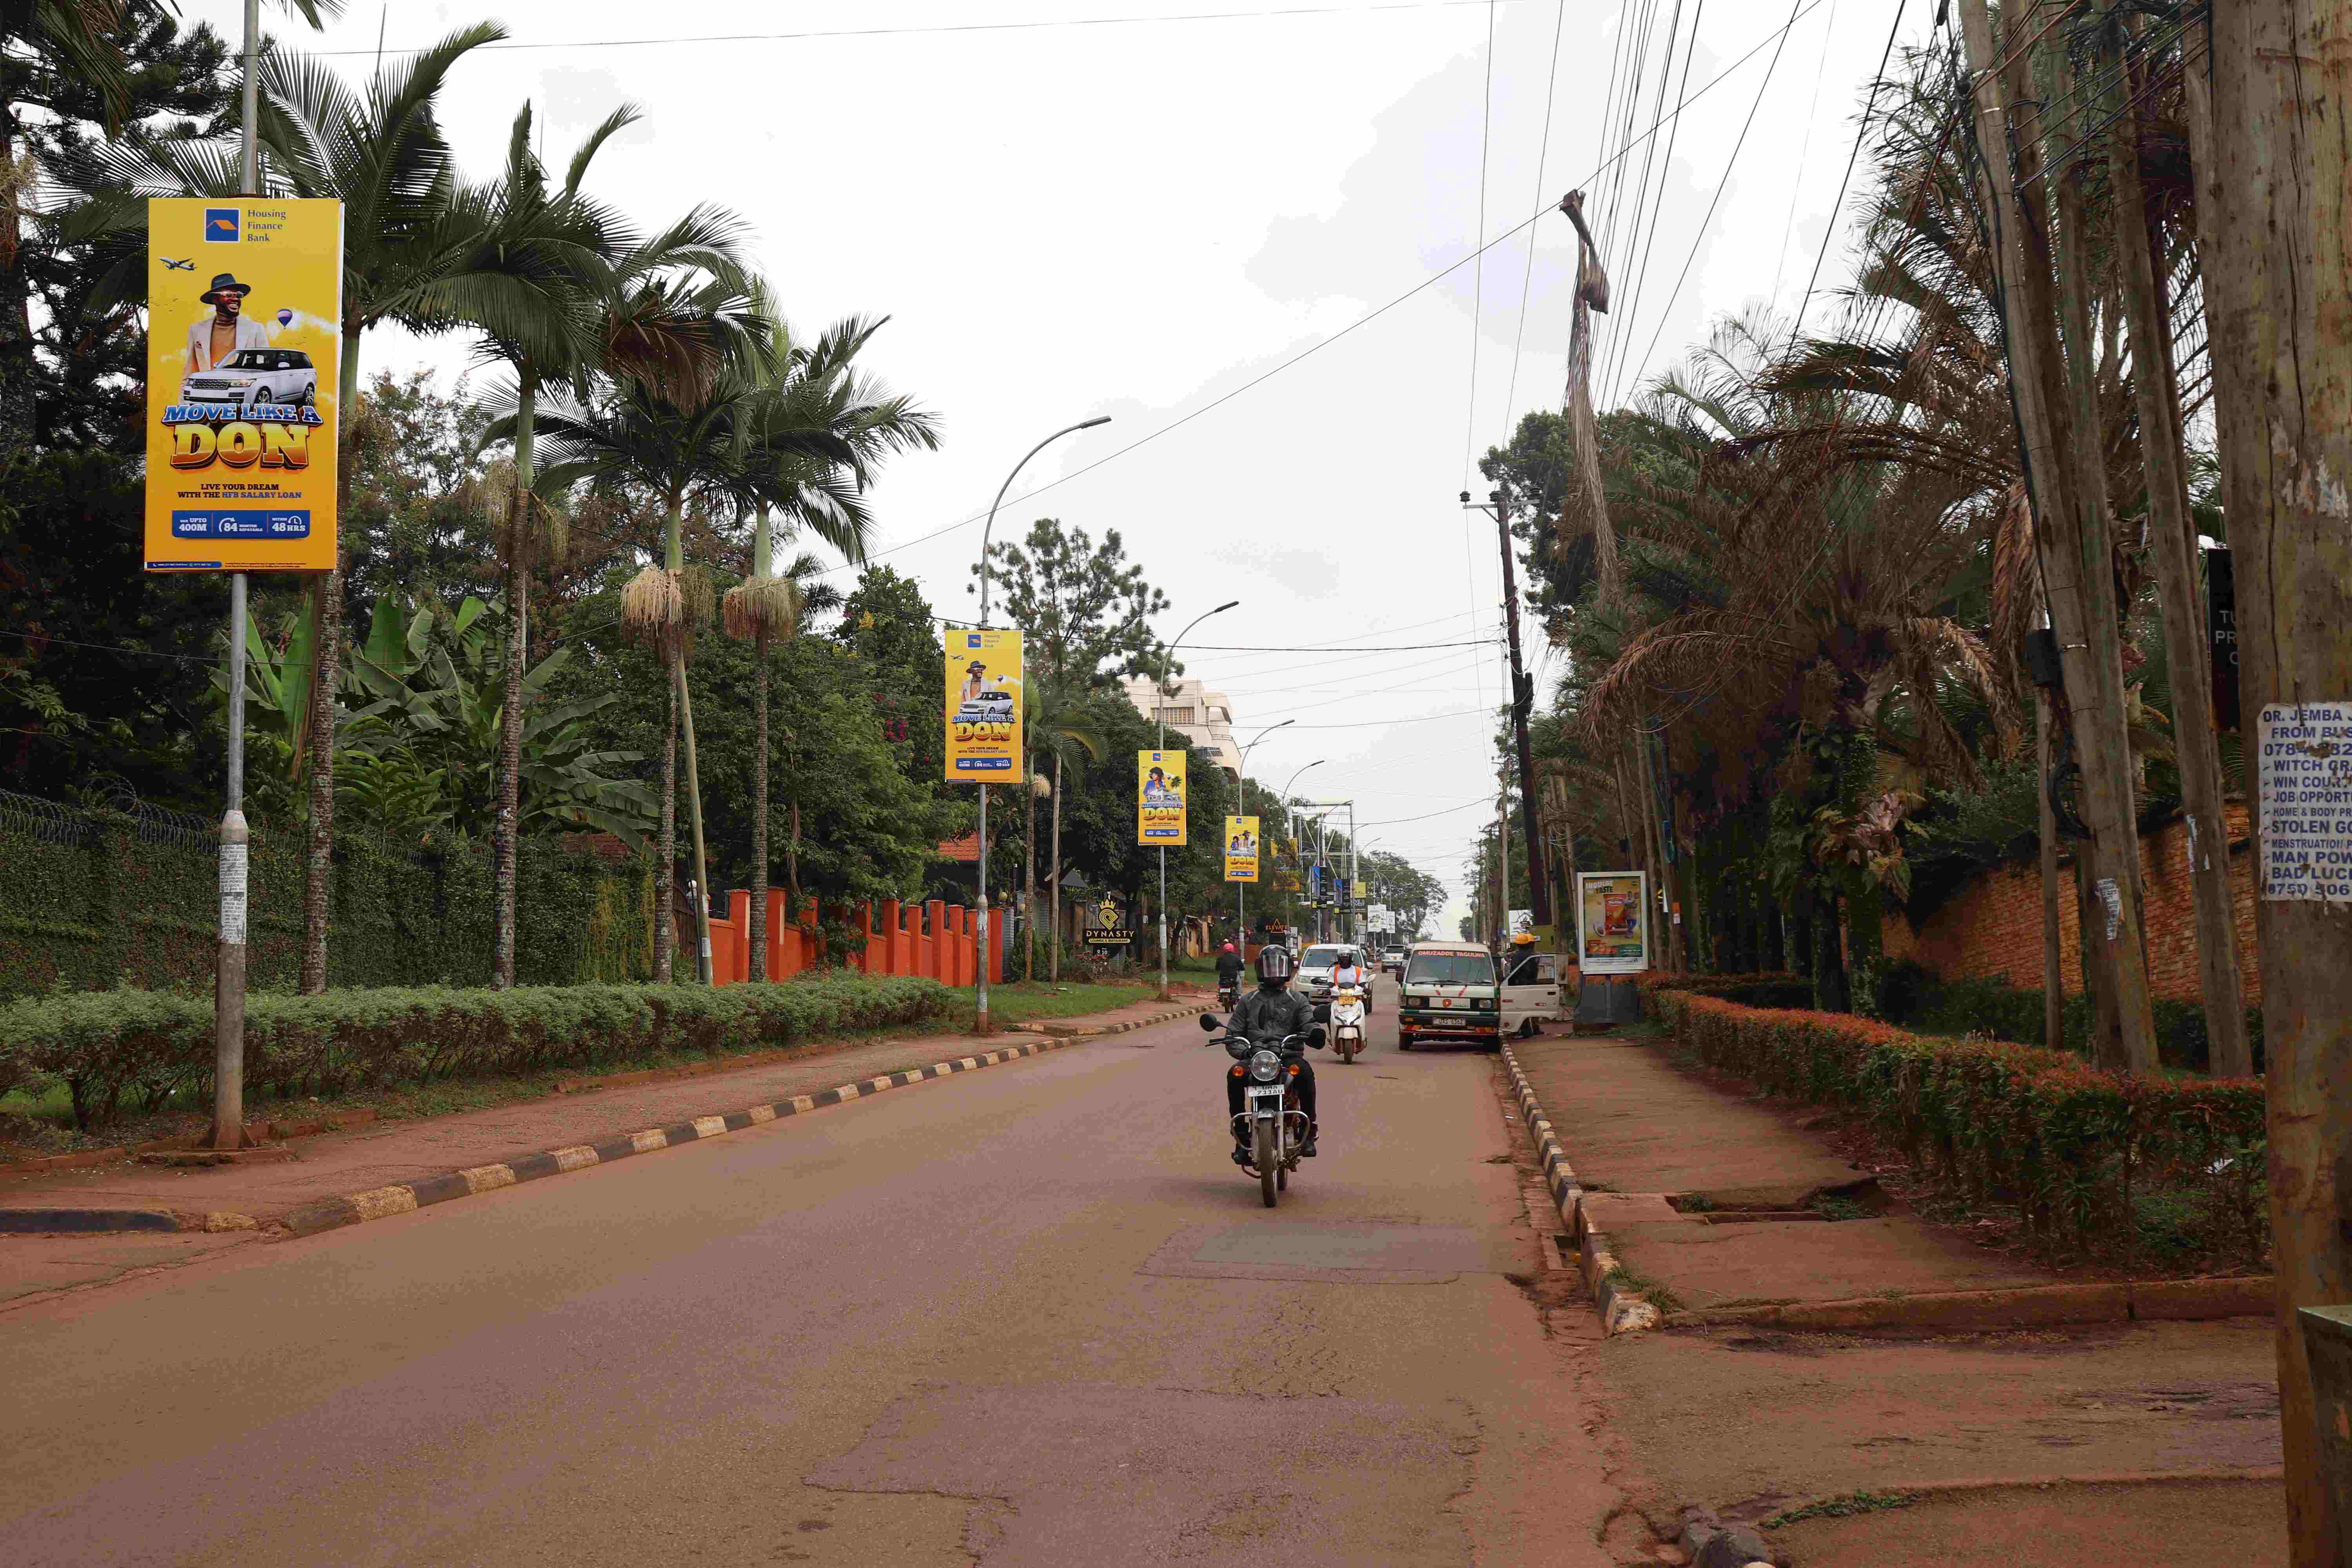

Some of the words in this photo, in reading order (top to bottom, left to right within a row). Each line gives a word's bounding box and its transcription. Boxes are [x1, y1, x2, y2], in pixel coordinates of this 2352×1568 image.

[248, 209, 286, 220] Housing
[248, 221, 282, 229] Finance
[248, 233, 270, 241] Bank
[162, 403, 237, 424] MOVE
[241, 403, 298, 423] LIKE
[300, 405, 323, 426] A
[171, 422, 310, 468] DON
[223, 523, 238, 532] 84
[272, 523, 286, 532] 48
[2263, 711, 2285, 722] DR.
[2290, 709, 2343, 722] JEMBA
[954, 722, 1011, 741] DON
[2272, 727, 2316, 738] FROM
[2274, 760, 2322, 771] WITCH
[2328, 760, 2352, 771] CR
[2274, 776, 2297, 788] WIN
[2274, 791, 2295, 802] JOB
[2299, 791, 2352, 802] OPPORT
[1143, 808, 1180, 820] DON
[2274, 808, 2298, 816] HOME
[2301, 808, 2308, 816] &
[2311, 808, 2336, 817] BODY
[2272, 820, 2330, 833] STOLEN
[2272, 851, 2308, 863] MAN
[2272, 867, 2305, 879] BAD
[2311, 867, 2352, 880] LUC
